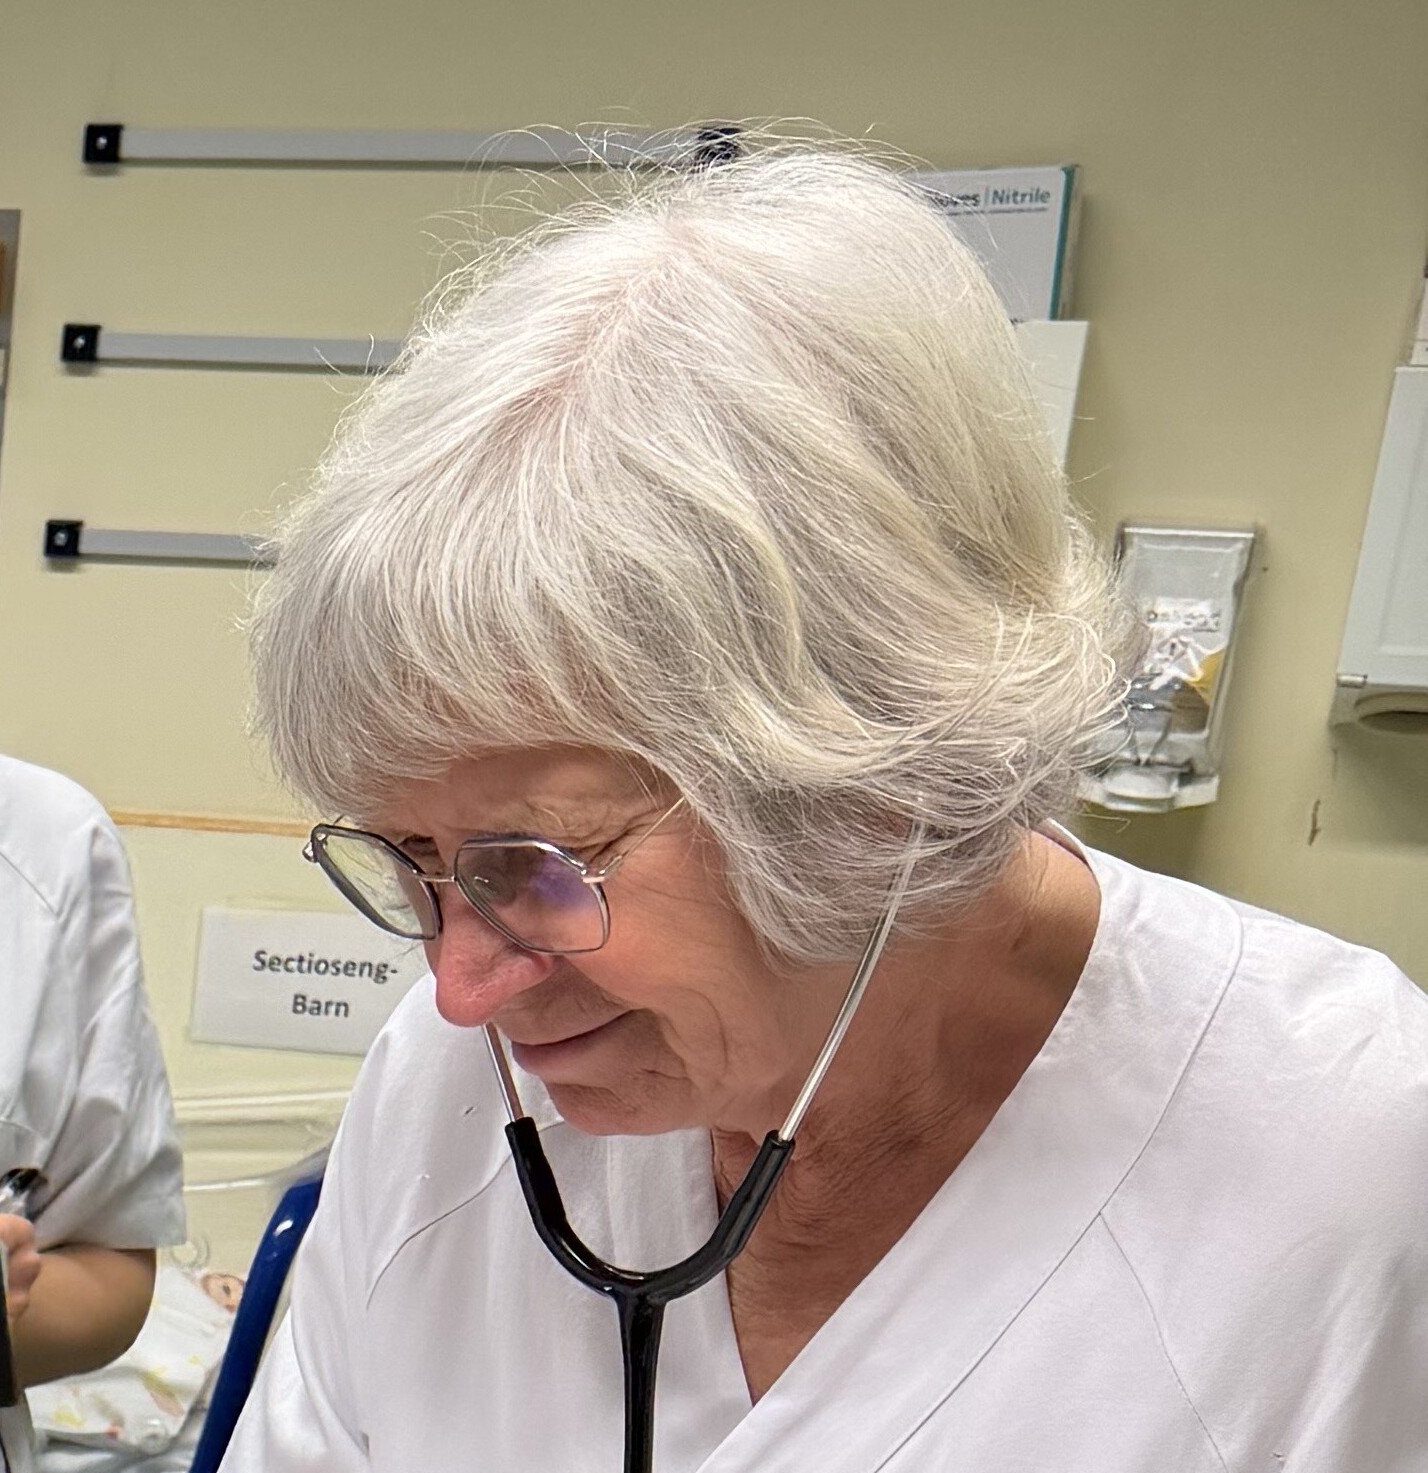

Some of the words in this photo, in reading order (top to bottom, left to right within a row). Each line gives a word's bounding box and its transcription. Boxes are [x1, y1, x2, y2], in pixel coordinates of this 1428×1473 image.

[993, 187, 1051, 206] Nitrile
[252, 950, 399, 985] Sectioseng-
[292, 994, 350, 1018] Barn
